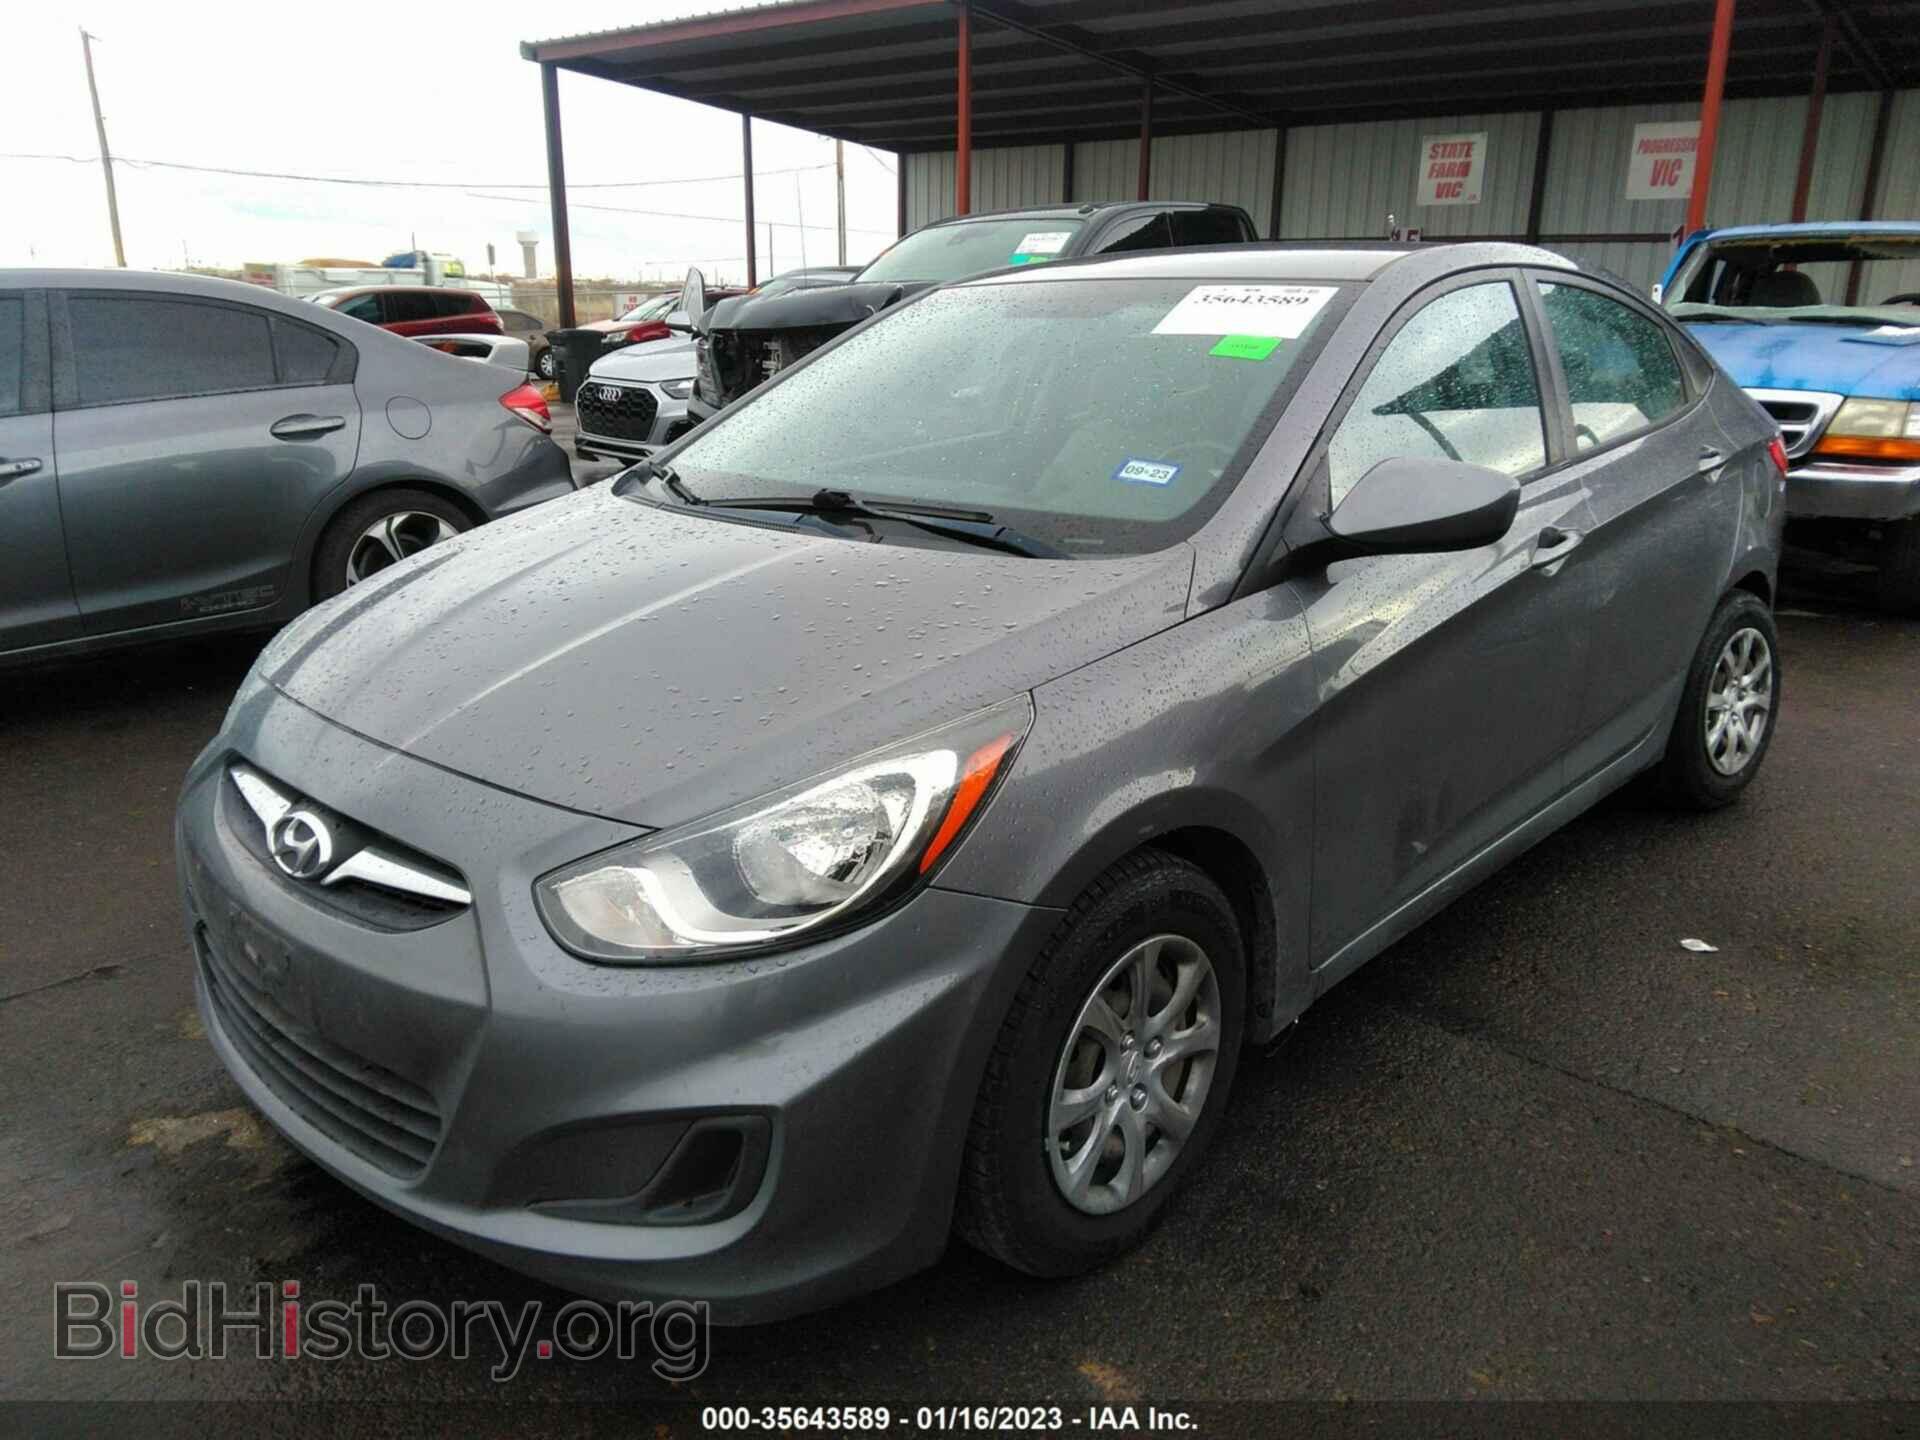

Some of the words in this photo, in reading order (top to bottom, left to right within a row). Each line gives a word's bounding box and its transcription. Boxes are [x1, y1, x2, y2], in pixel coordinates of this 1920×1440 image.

[1429, 143, 1472, 160] STATE
[1636, 137, 1698, 154] PROGRESSIV
[1428, 161, 1472, 180] FARM
[1649, 159, 1683, 187] VIC
[1435, 181, 1464, 199] VIC
